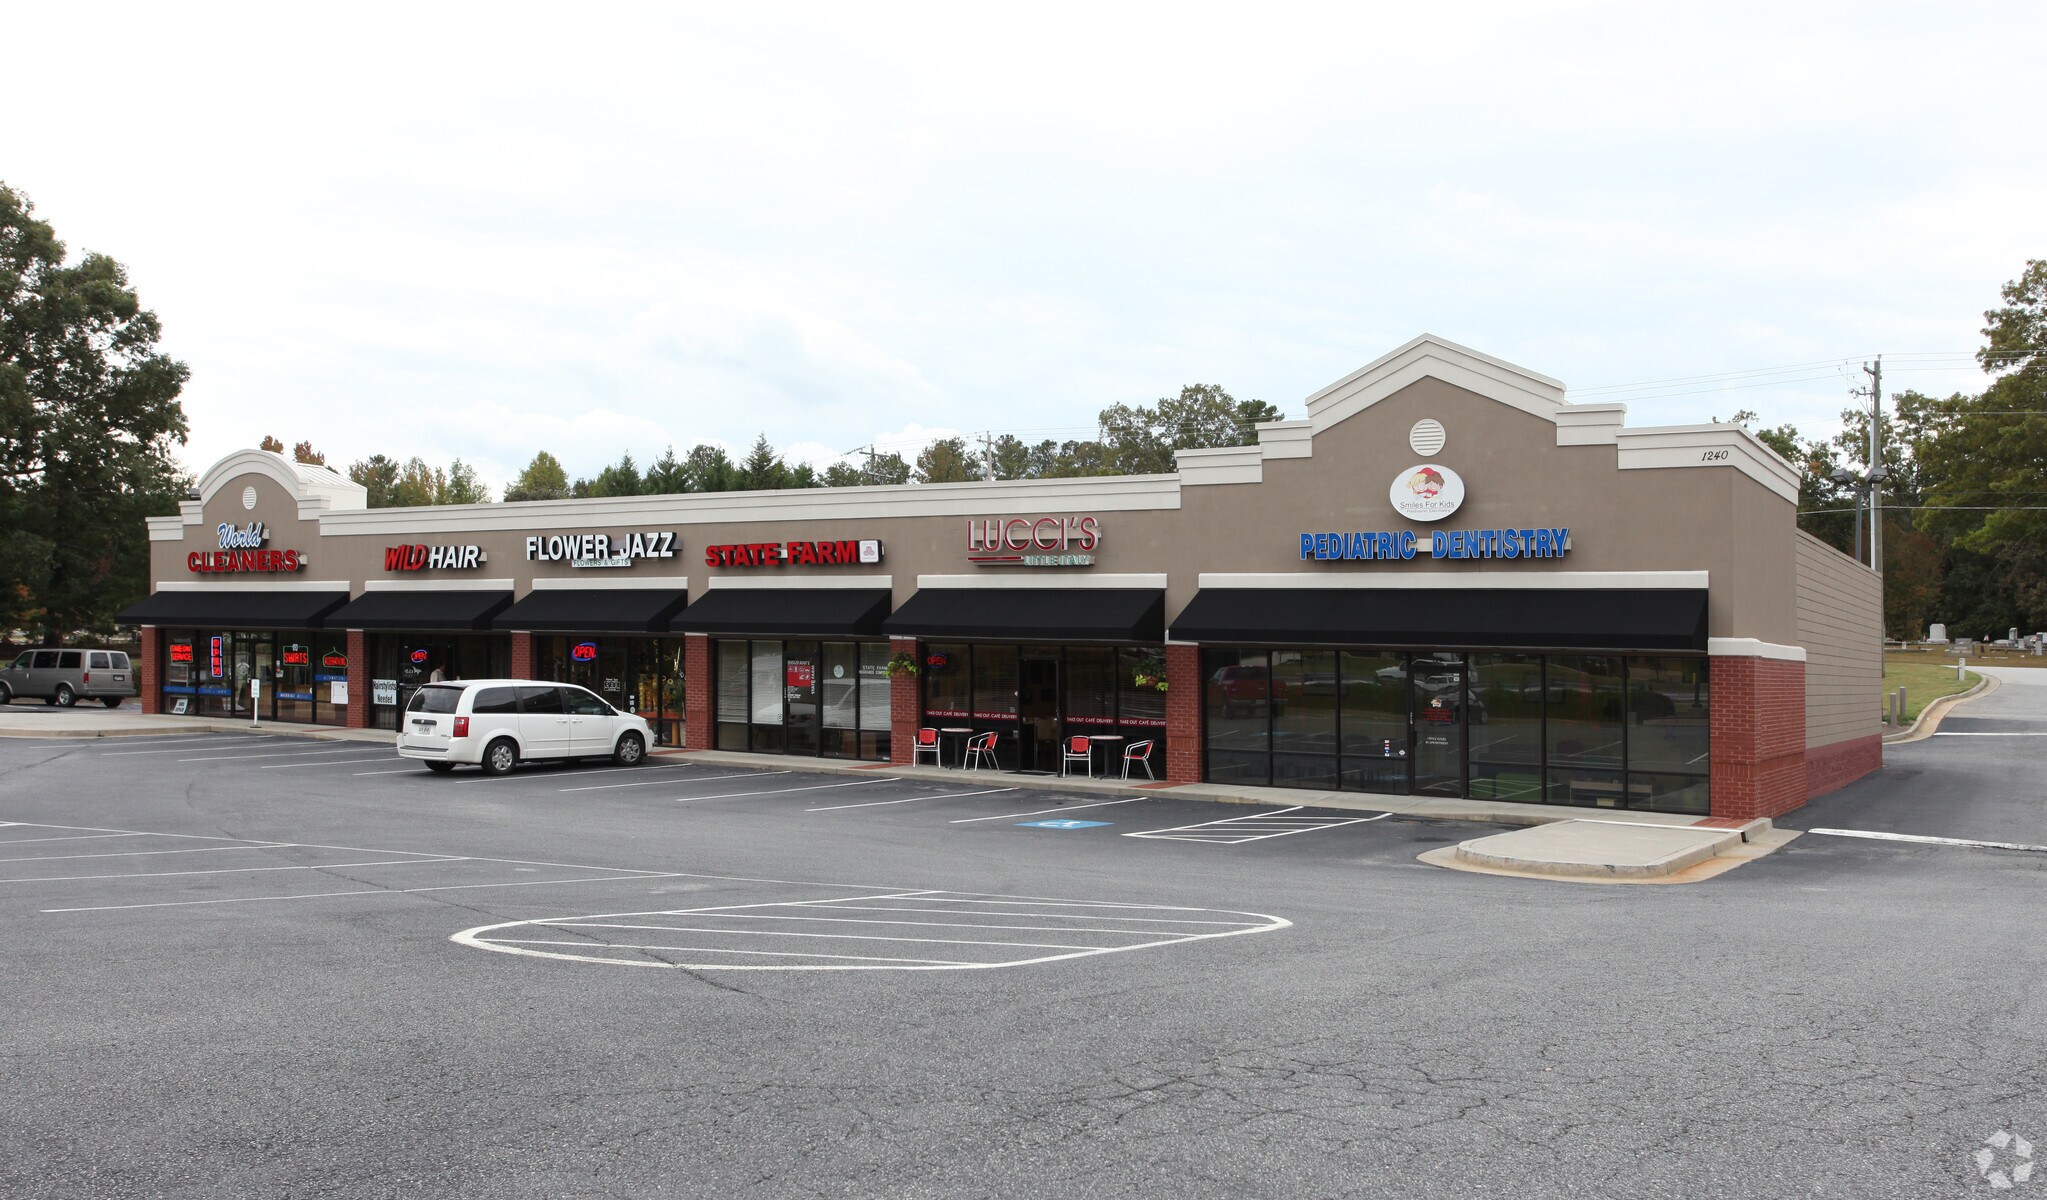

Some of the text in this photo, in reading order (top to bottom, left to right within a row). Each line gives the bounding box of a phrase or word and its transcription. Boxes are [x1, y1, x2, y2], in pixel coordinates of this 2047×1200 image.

[1702, 450, 1729, 461] 1240
[217, 522, 262, 549] World
[967, 516, 1099, 552] LUCCI'S
[526, 532, 674, 561] FLOWER JAZZ
[1300, 527, 1570, 560] PEDIATRIC DENTISTRY
[384, 544, 479, 571] WILD HAIR
[705, 540, 858, 568] STATE FARM
[1023, 554, 1091, 565] LITTLE ITALY
[187, 549, 299, 573] CLEANERS
[573, 559, 602, 567] FLOWERS
[610, 558, 629, 566] GIFTS
[411, 652, 426, 661] OPEN
[574, 645, 596, 658] OPEN
[284, 652, 307, 664] SHIRTS
[927, 656, 946, 665] OPEN
[373, 681, 396, 692] Hairstylists
[377, 694, 393, 704] Needed
